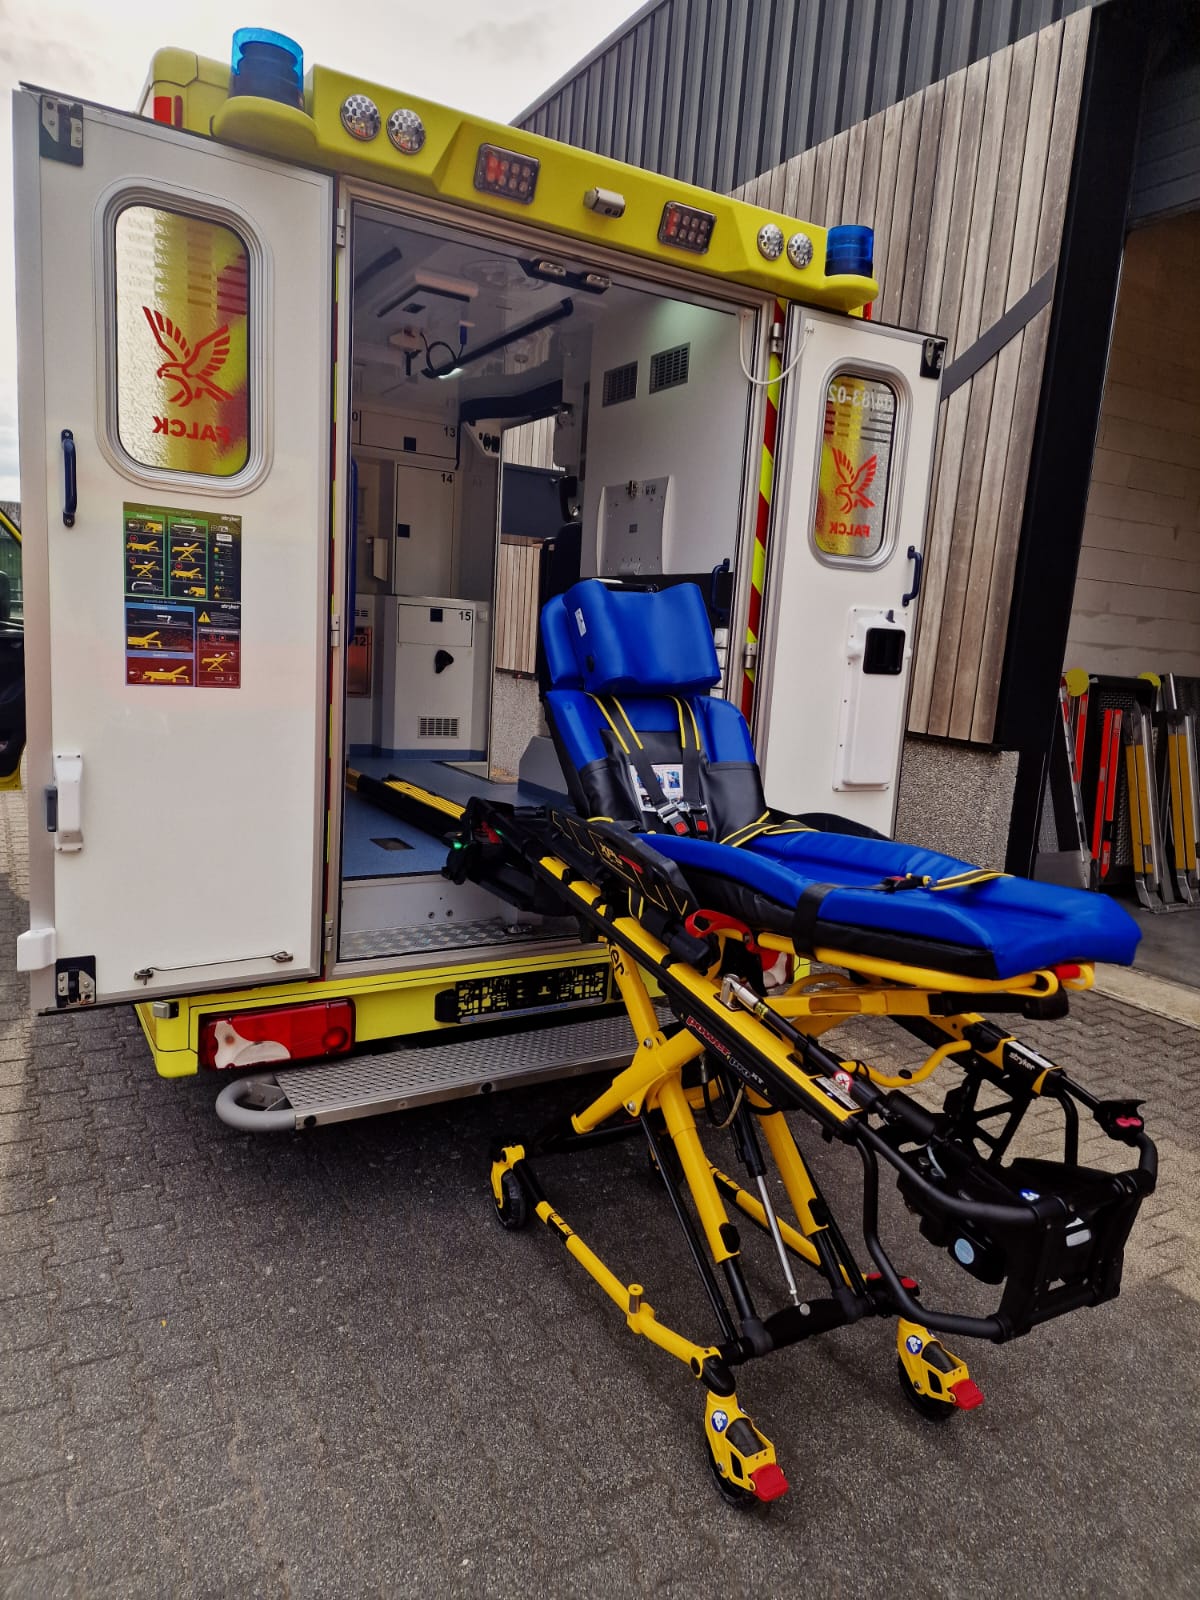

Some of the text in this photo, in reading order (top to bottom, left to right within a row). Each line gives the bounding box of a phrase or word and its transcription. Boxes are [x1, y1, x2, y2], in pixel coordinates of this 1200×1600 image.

[443, 424, 456, 438] 13
[441, 473, 453, 484] 14
[459, 611, 472, 621] 15
[355, 636, 367, 646] 12
[1009, 1052, 1036, 1071] stryker
